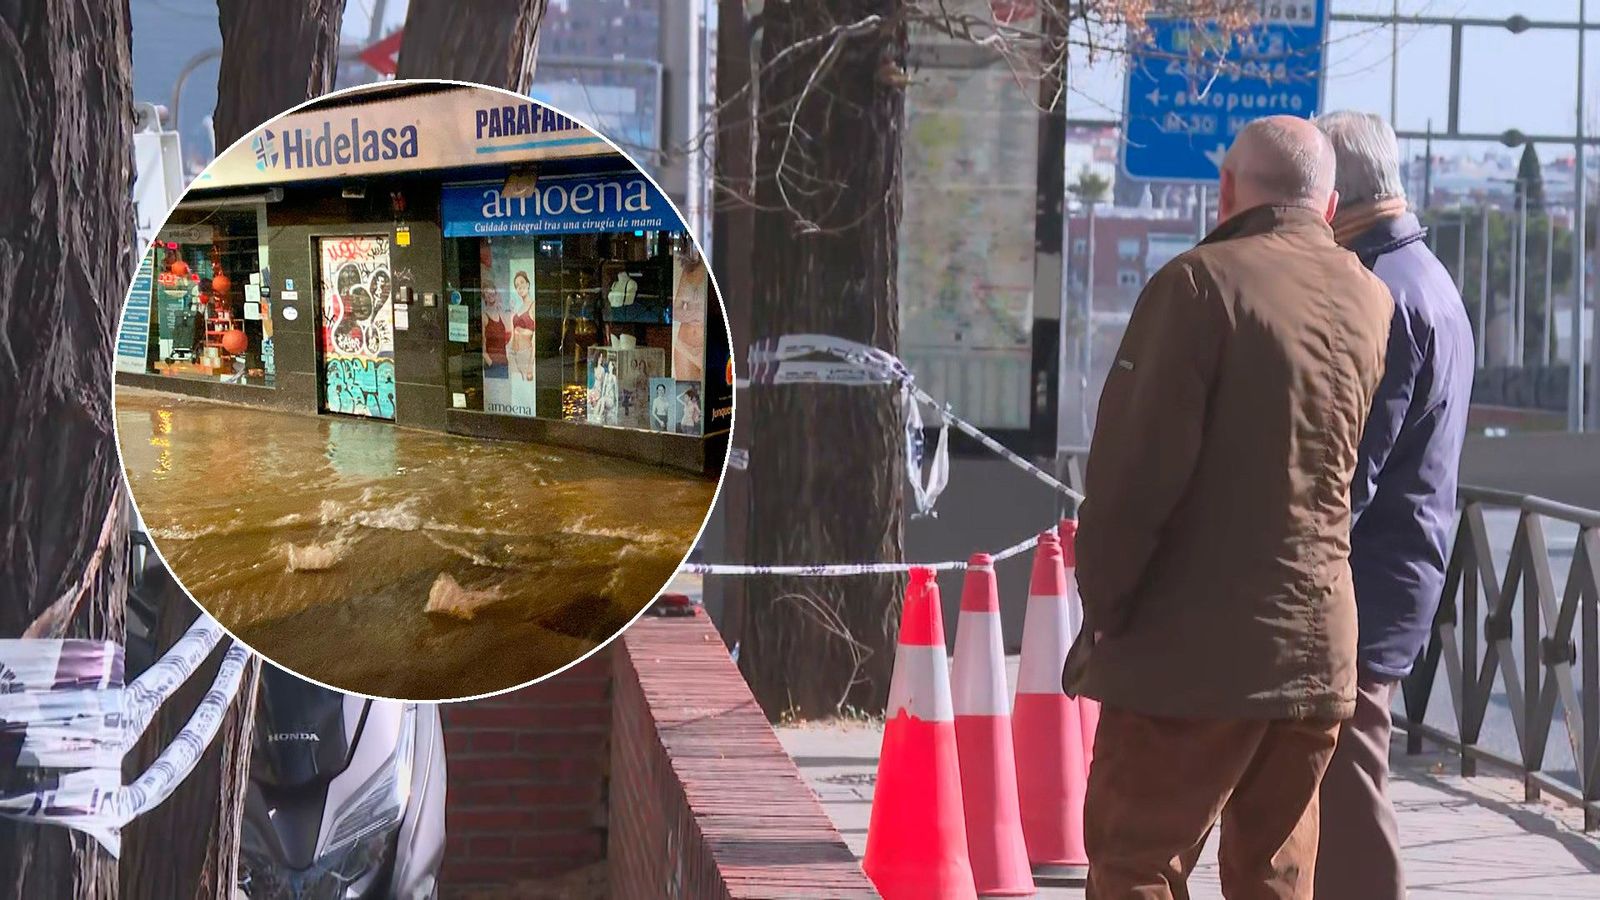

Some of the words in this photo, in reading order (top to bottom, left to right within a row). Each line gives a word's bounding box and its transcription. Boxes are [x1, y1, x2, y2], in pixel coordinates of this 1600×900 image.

[1175, 92, 1303, 112] aeropuerto
[283, 118, 419, 169] Hidelasa
[481, 179, 652, 219] amoena
[474, 222, 508, 233] Cuidado
[510, 221, 543, 234] integral
[544, 221, 561, 231] tras
[563, 222, 580, 230] una
[582, 218, 615, 232] cirugía
[617, 217, 629, 229] de
[631, 218, 663, 228] mama
[487, 402, 532, 416] amoena
[267, 732, 321, 742] HONDA
